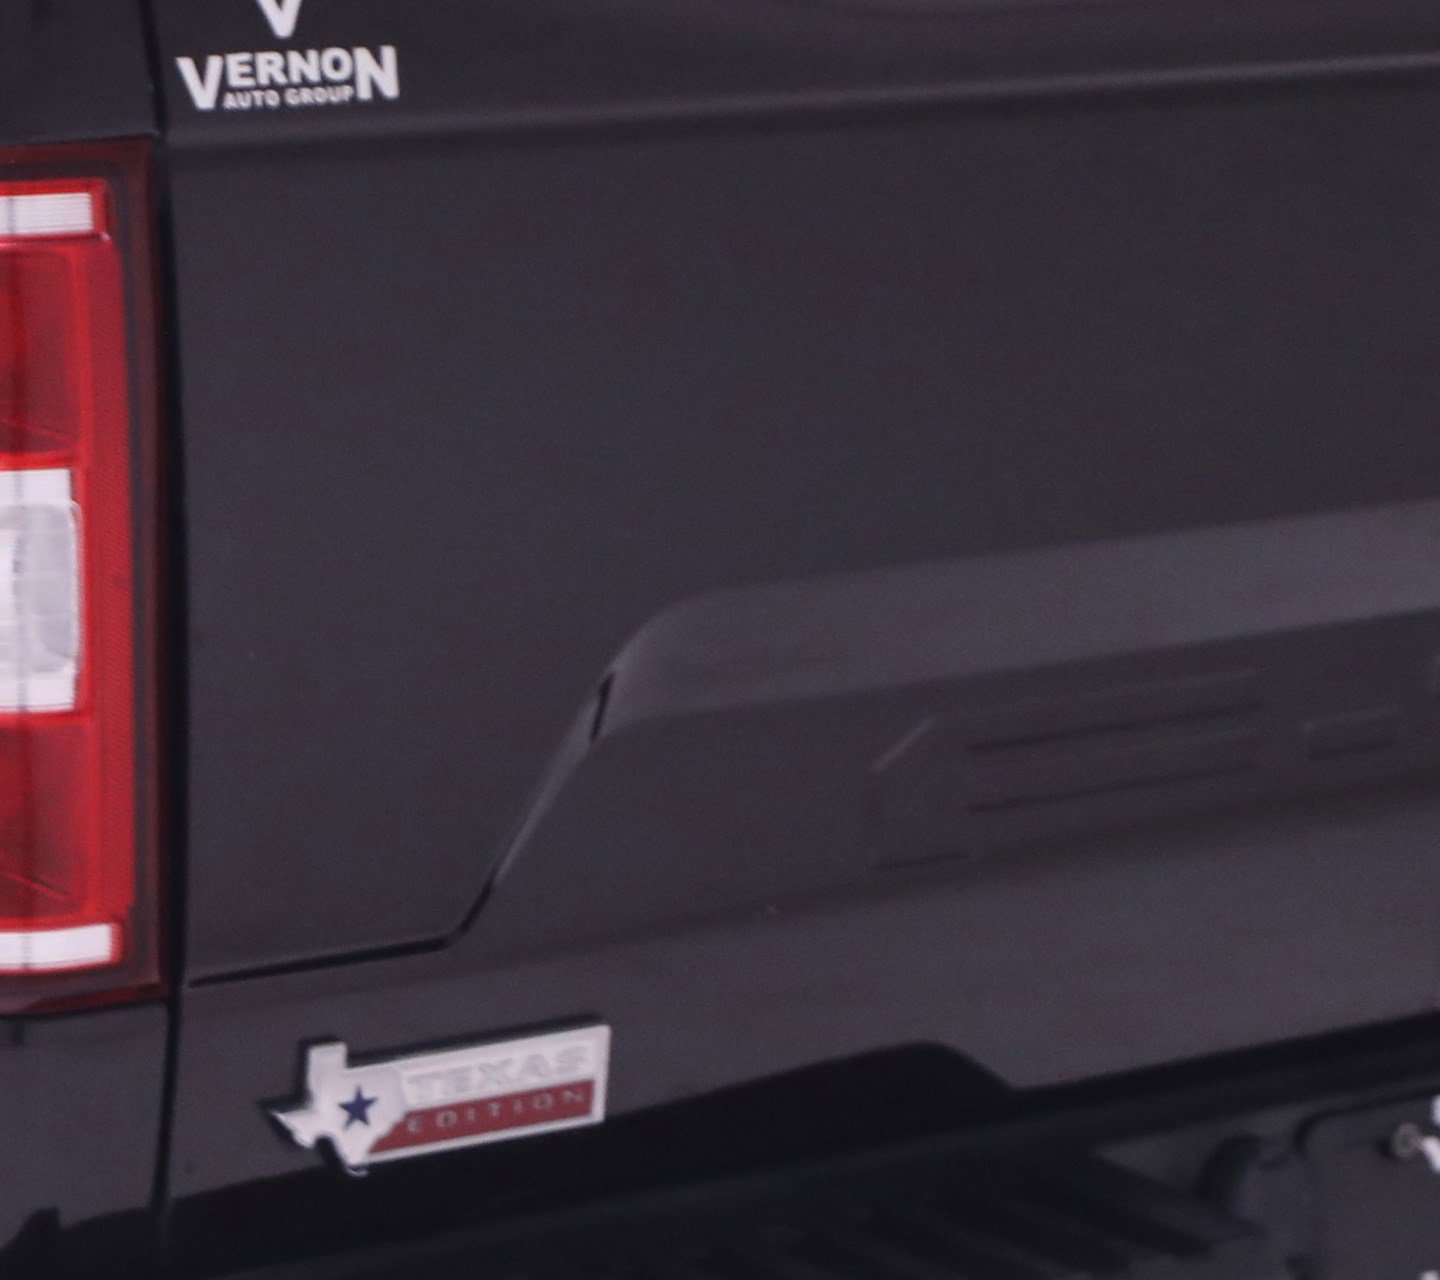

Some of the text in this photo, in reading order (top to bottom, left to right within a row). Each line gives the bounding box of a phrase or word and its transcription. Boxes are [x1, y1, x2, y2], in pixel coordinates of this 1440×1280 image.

[175, 45, 400, 111] VERNON
[223, 85, 355, 110] AUTO GROUP
[406, 1088, 586, 1133] EDITION
